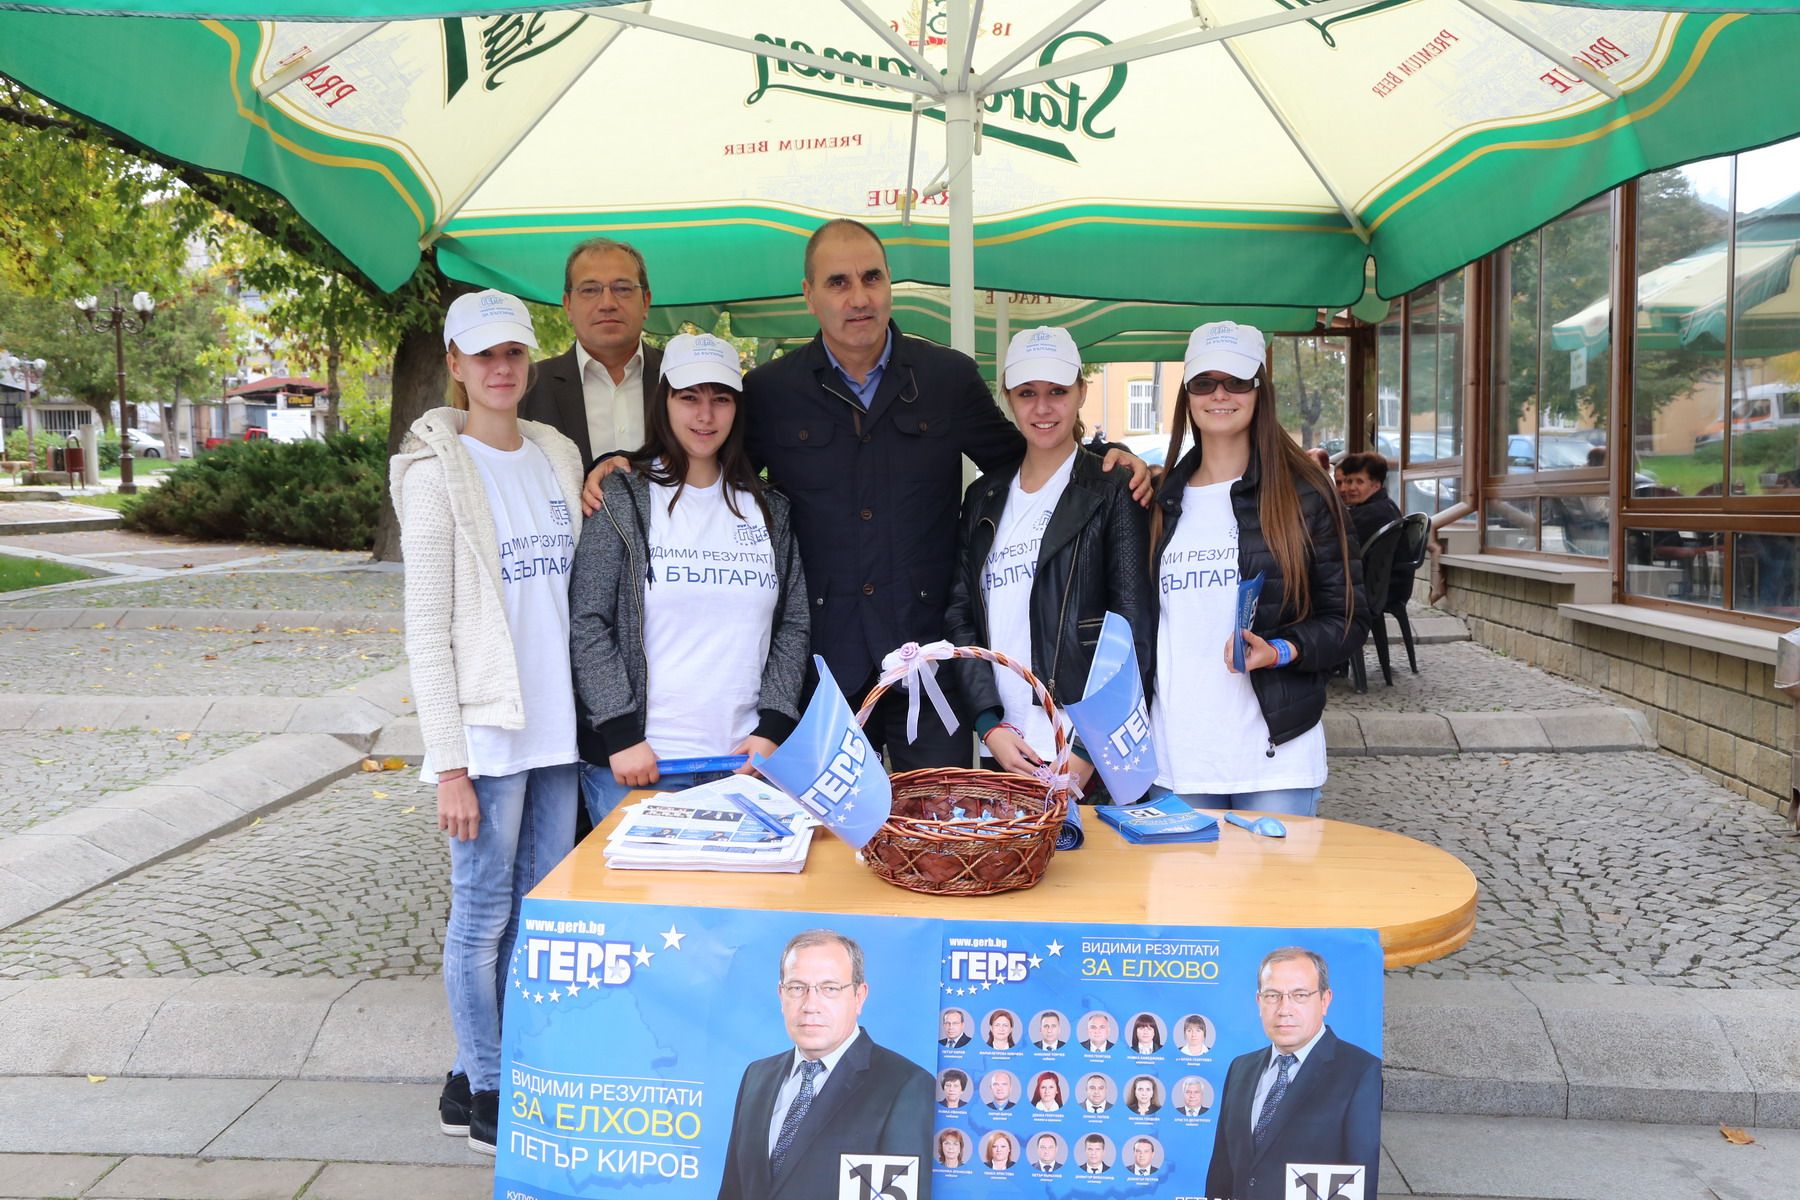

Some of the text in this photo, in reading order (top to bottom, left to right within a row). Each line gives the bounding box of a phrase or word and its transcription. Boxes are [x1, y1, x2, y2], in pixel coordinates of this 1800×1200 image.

[666, 565, 778, 590] БЪЛГАРИЯ
[798, 727, 867, 817] ГЕРБ
[525, 918, 606, 936] www.gerb.bg
[949, 937, 1008, 949] www.gerb.bg
[527, 938, 632, 986] ГЕРБ
[1082, 941, 1220, 957] ВИДИМИ РЕЗУЛТАТИ
[951, 951, 1028, 982] ГЕРБ
[1081, 957, 1220, 980] ЗА ЕЛХОВО
[511, 1068, 703, 1107] ВИДИМИ РЕЗУЛТАТИ
[511, 1091, 702, 1140] ЗА ЕЛХОВО
[510, 1130, 700, 1180] ПЕТЪР КИРОВ
[848, 1163, 909, 1200] 15
